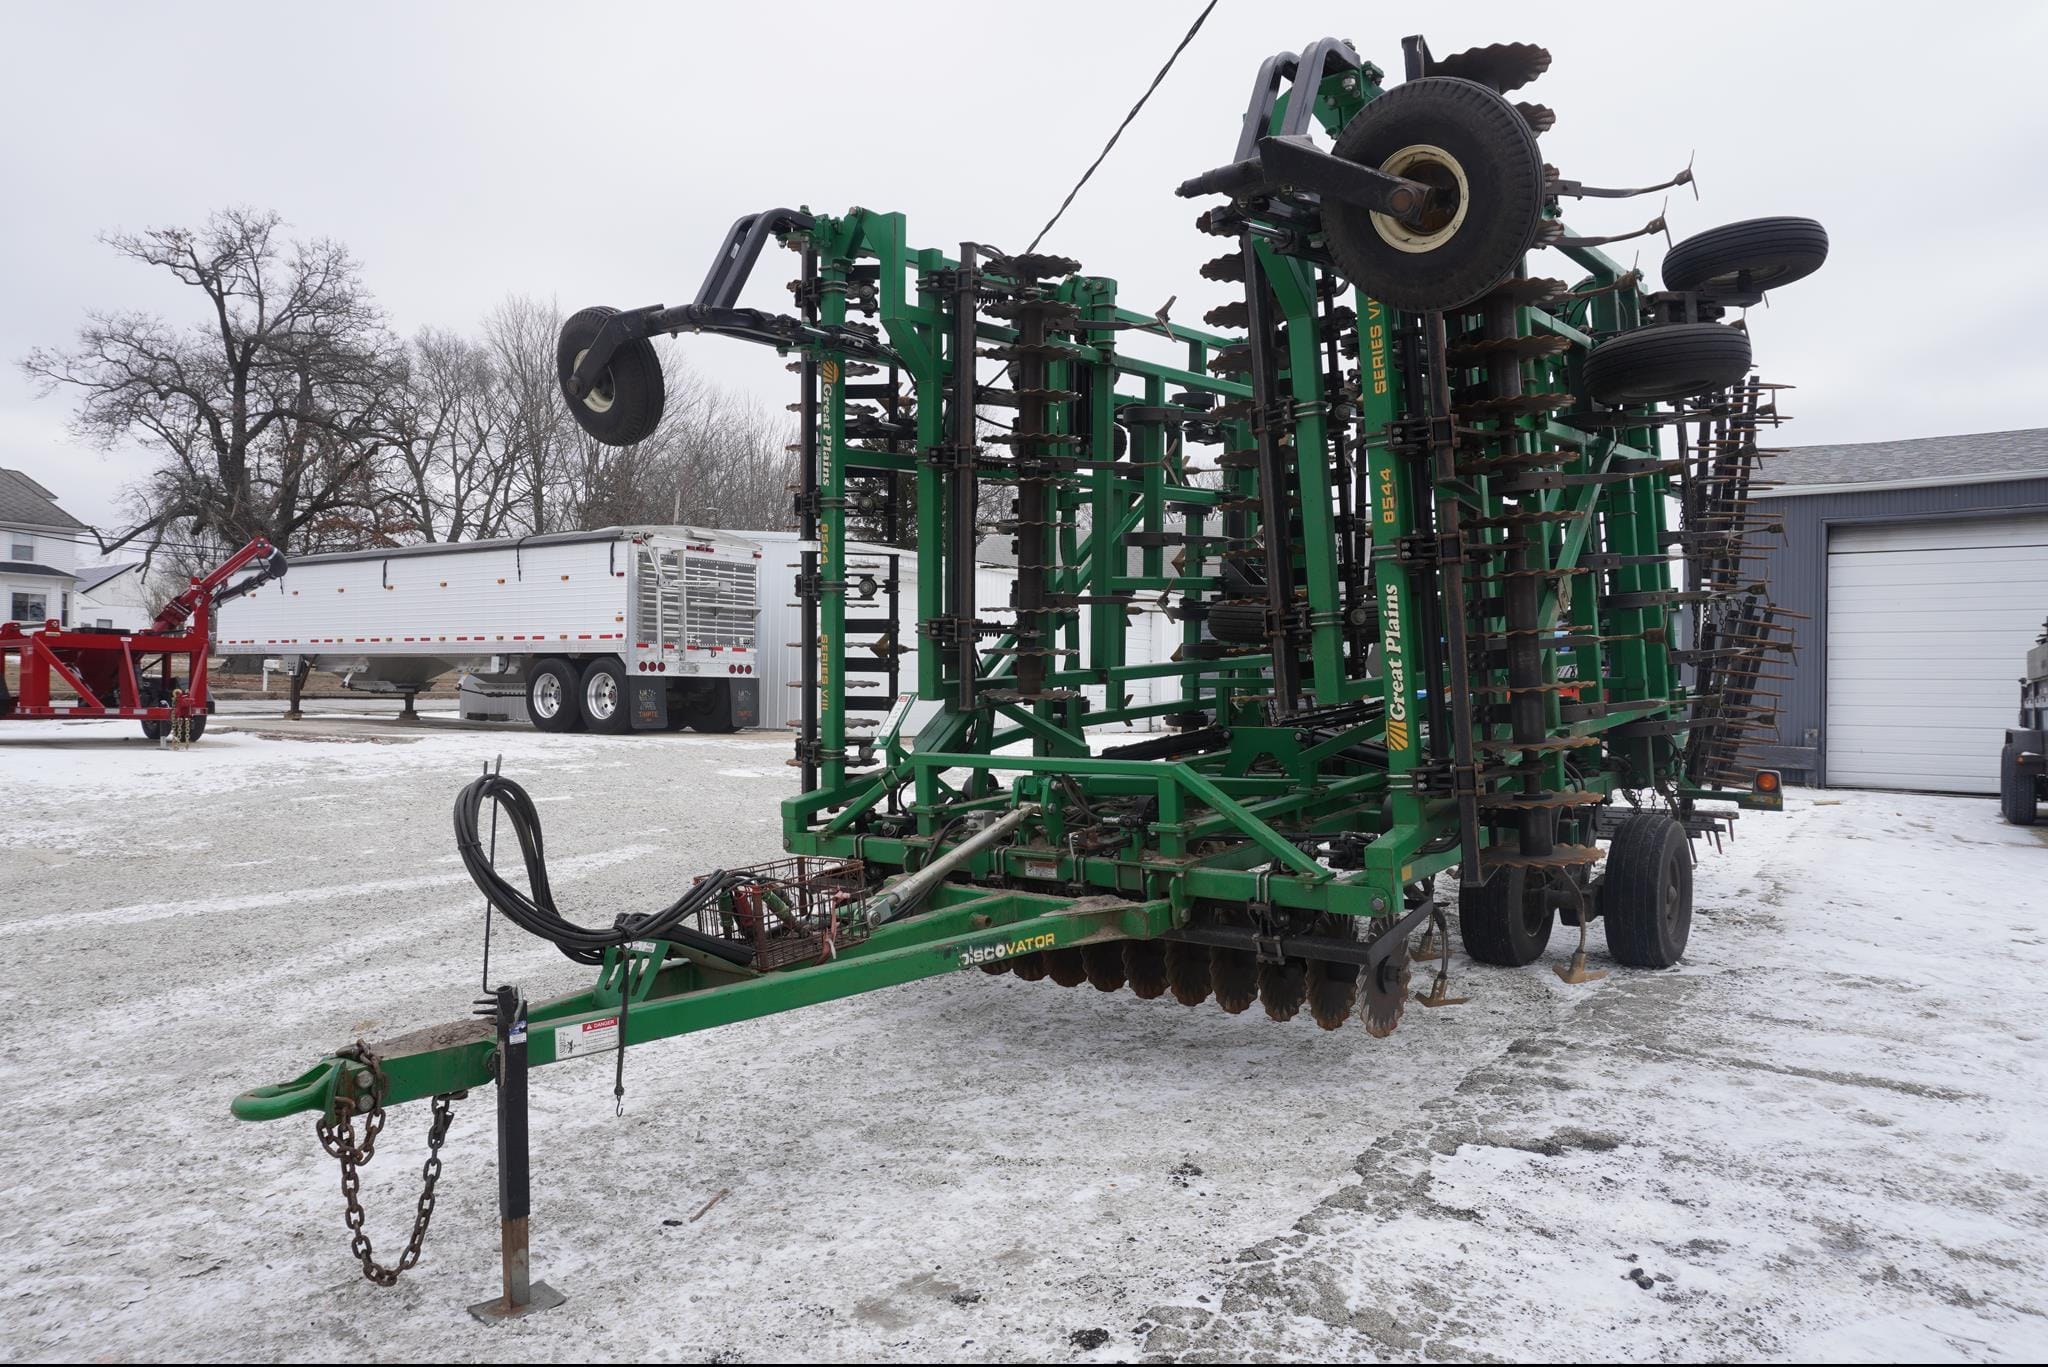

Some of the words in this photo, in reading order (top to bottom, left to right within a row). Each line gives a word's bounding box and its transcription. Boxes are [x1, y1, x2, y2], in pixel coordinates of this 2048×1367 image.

[1370, 325, 1388, 394] SERIES
[822, 383, 833, 431] Great
[822, 434, 833, 487] Plains
[1379, 468, 1395, 524] 8544
[820, 523, 829, 565] 8544
[1383, 583, 1402, 654] Plains
[820, 633, 829, 685] SERIES
[820, 689, 829, 711] VIII
[1389, 657, 1407, 723] Great
[593, 1019, 615, 1028] DANGER
